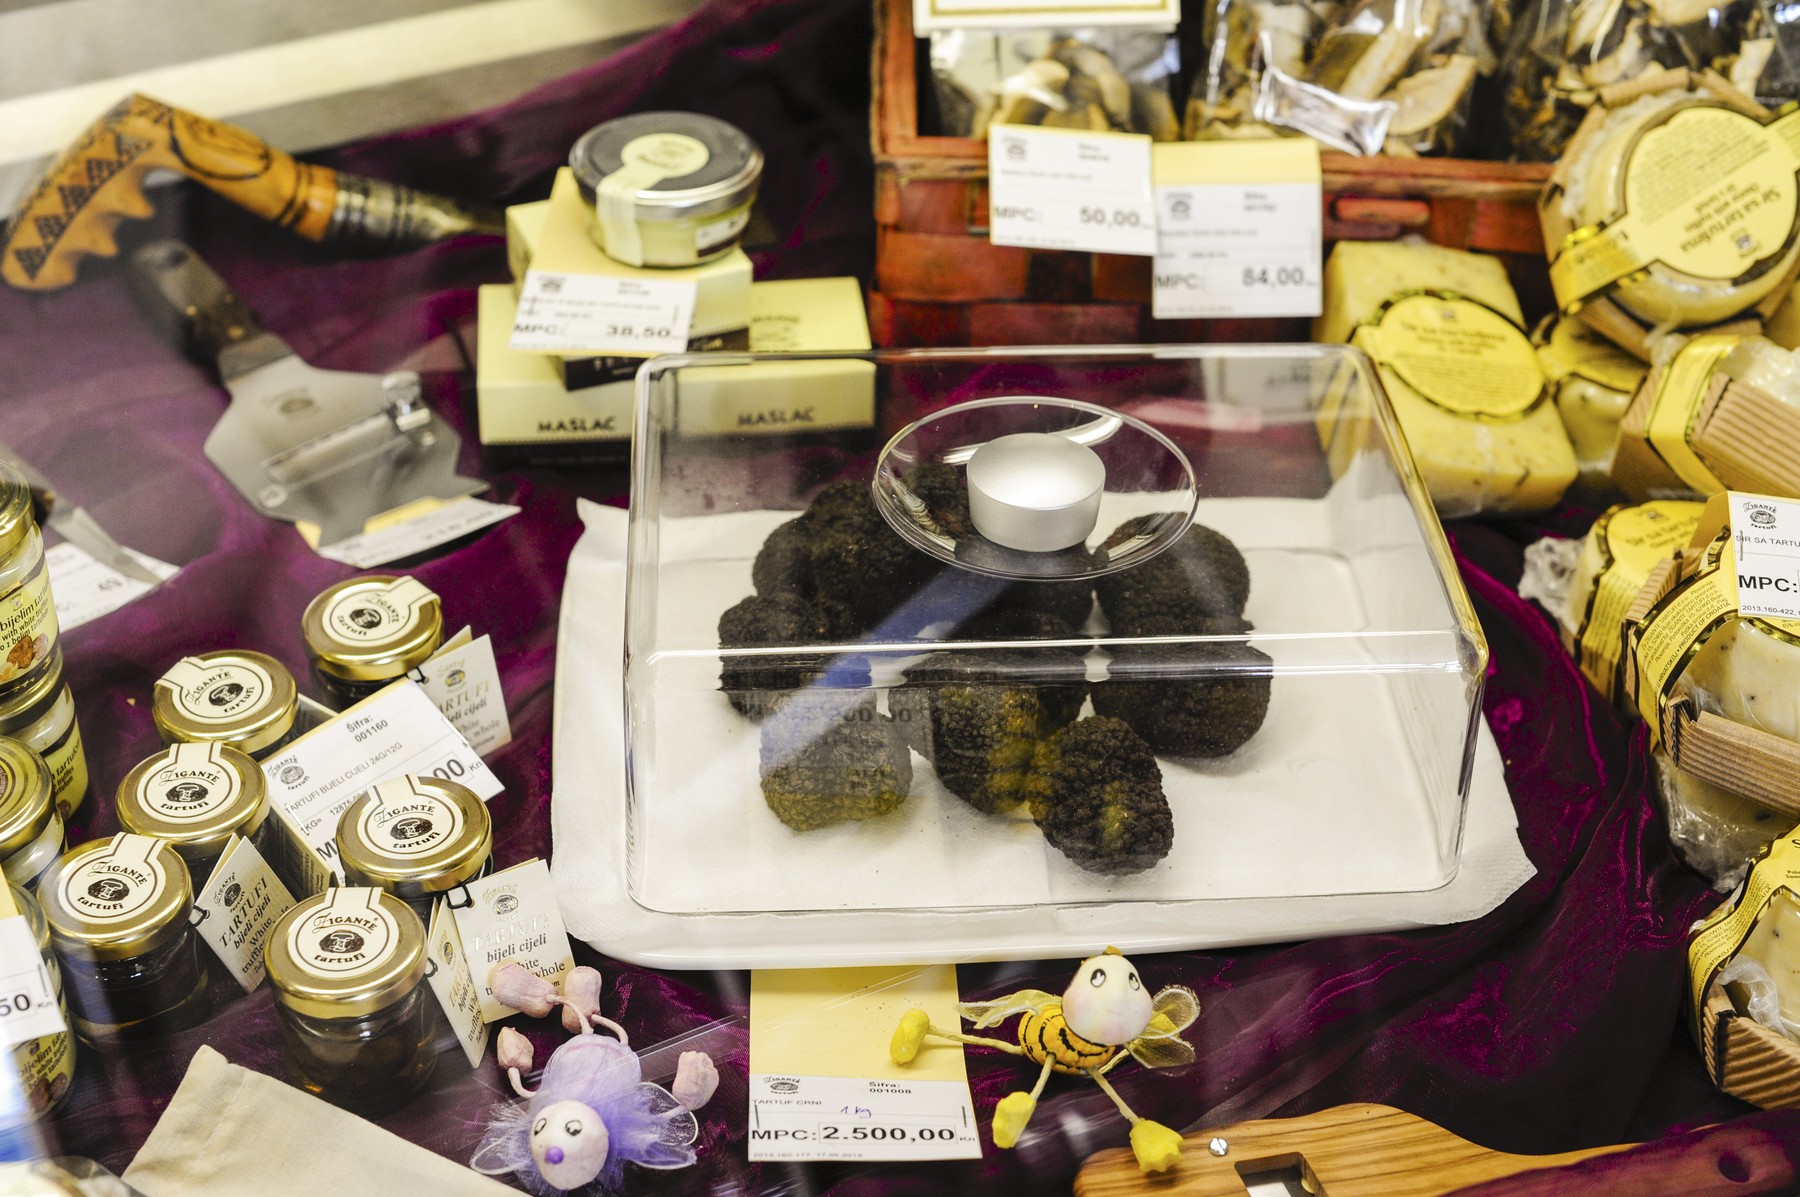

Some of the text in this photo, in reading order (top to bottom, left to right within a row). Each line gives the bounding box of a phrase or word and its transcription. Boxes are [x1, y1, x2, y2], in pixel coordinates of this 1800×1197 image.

[1079, 206, 1141, 230] 50,00
[1154, 267, 1305, 291] MPC: 84,00
[606, 323, 671, 339] 38,50
[538, 416, 616, 433] MASLAC
[738, 406, 816, 427] MASLAC
[1743, 501, 1778, 514] ZIGANTE
[1735, 535, 1752, 543] SIR
[1738, 574, 1798, 593] MPC:
[0, 604, 35, 632] bijelim
[1, 627, 18, 641] with
[19, 616, 35, 631] white
[337, 615, 368, 636] tartufi
[1679, 624, 1700, 650] PRODUCT
[1698, 617, 1706, 626] OF
[1705, 602, 1731, 619] CROATIA
[184, 671, 233, 706] ZIGANTE
[223, 686, 255, 713] tartufi
[438, 679, 492, 713] ARTUFI
[346, 714, 374, 733] Šifra:
[354, 719, 389, 743] 001160
[159, 766, 220, 786] ZIGANTE
[268, 756, 299, 779] ZIGANTE
[284, 741, 403, 815] TARTUFI BIJELI CIJELI 24G/12G
[468, 761, 483, 772] Kn
[287, 775, 310, 791] tartufi
[160, 801, 210, 811] tartufi
[373, 804, 436, 828] ZIGANTE
[393, 831, 442, 848] tartufi
[87, 859, 149, 885] ZIGANTE
[77, 896, 124, 910] tartufi
[219, 876, 269, 949] TARTUFI
[232, 894, 271, 949] bijeli cijeli
[249, 917, 272, 947] White
[312, 912, 378, 934] ZIGANTE
[471, 912, 551, 951] TARTUFI
[314, 952, 367, 964] tartufi
[486, 932, 548, 964] bijeli cijeli
[1703, 948, 1730, 978] HRVATSKOJ
[840, 1106, 872, 1118] 1 kg
[752, 1130, 817, 1141] MPC:
[822, 1126, 955, 1143] 2.500,00
